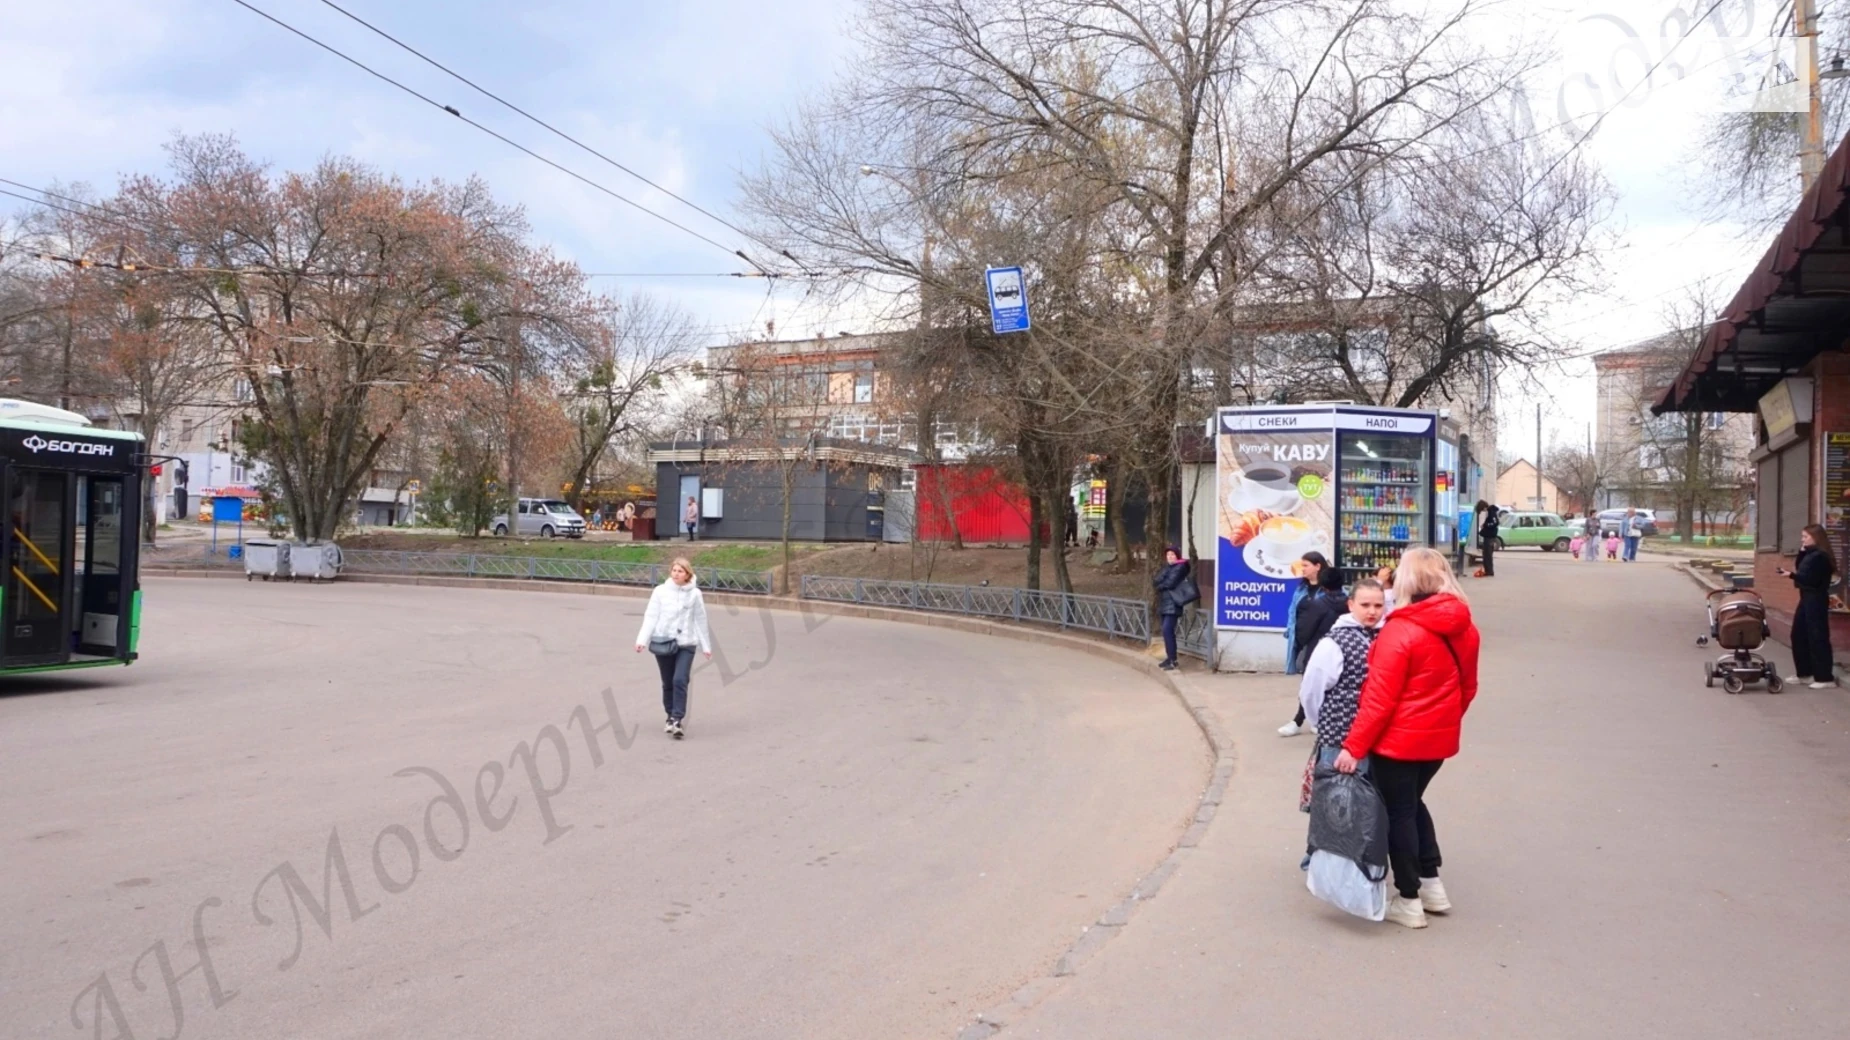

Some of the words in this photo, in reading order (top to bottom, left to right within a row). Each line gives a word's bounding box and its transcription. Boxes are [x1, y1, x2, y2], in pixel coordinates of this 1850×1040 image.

[1258, 417, 1297, 426] СНЕКИ
[1366, 417, 1398, 429] НАПОЇ
[48, 440, 114, 456] БОГДАН
[1239, 443, 1270, 454] Купуй
[1273, 444, 1330, 461] КАВУ
[1303, 483, 1318, 491] ТУТ
[1225, 581, 1286, 593] ПРОДУКТИ
[1225, 595, 1262, 606] НАПОЇ
[1224, 610, 1271, 621] ТЮТЮН
